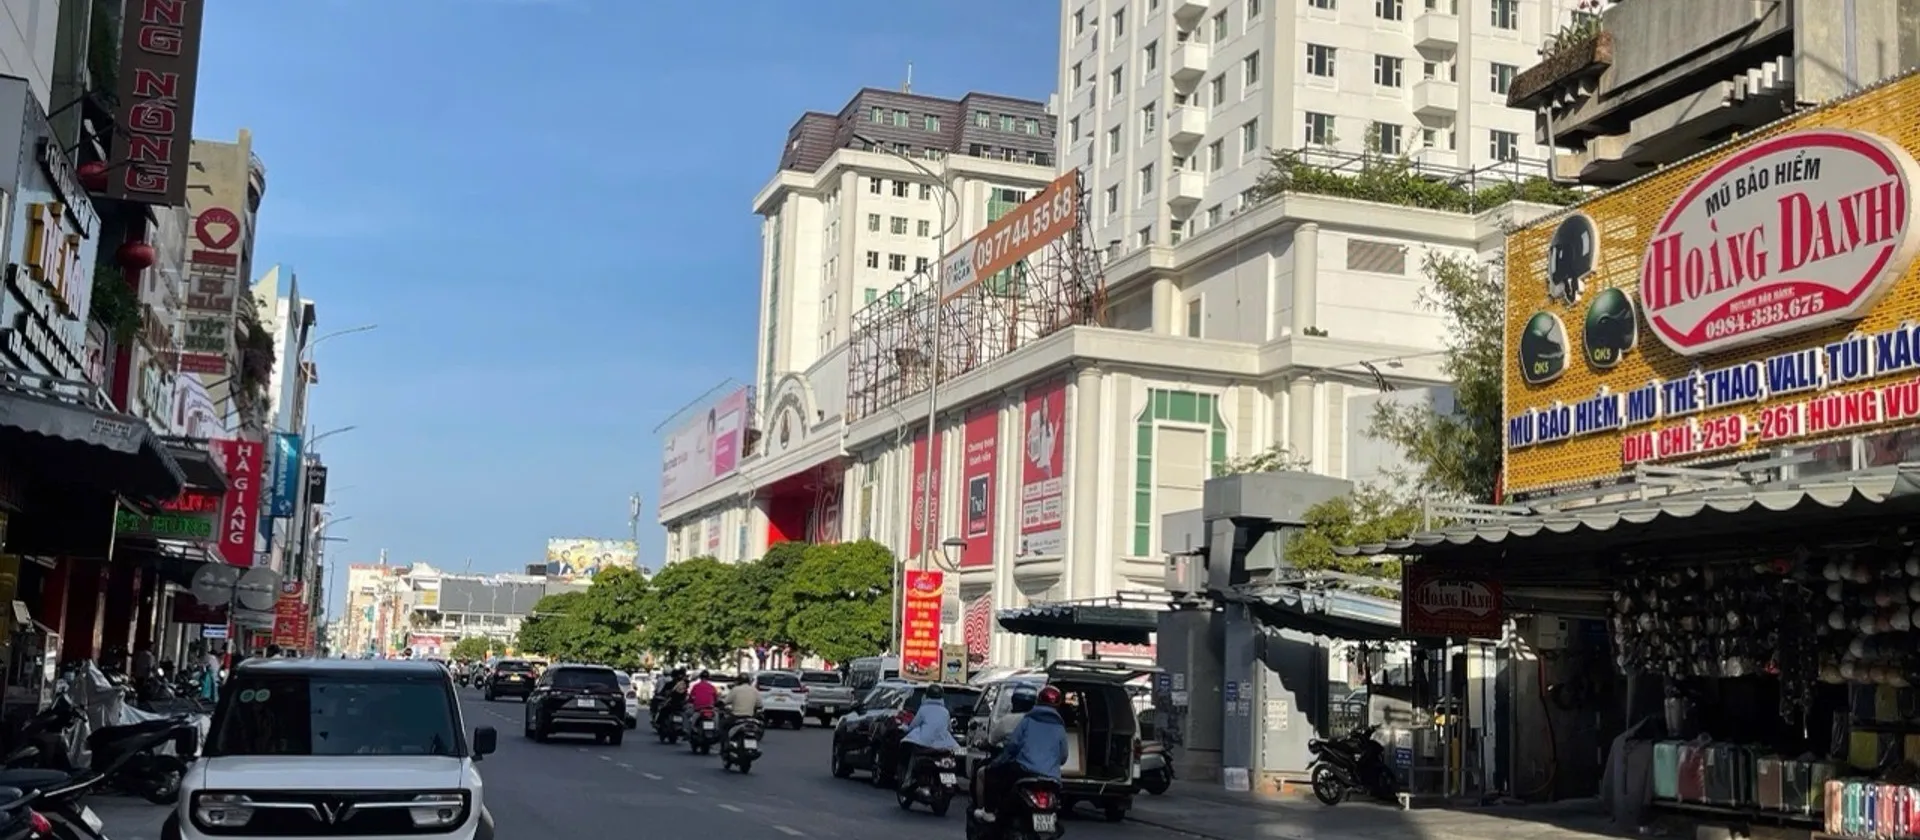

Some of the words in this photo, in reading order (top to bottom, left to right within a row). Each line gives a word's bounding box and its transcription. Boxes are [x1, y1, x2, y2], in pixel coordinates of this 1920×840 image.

[1704, 183, 1731, 217] MŨ
[1736, 165, 1769, 201] BẢO
[1774, 150, 1821, 185] HIỂM
[977, 238, 993, 270] 09
[1032, 200, 1050, 238] 55
[1777, 180, 1895, 273] DANH
[1705, 292, 1824, 339] 0984.333.675
[1826, 333, 1868, 381] TÚI
[1703, 415, 1740, 449] 259
[1761, 407, 1800, 439] 261
[235, 444, 252, 471] HÀ
[229, 477, 248, 544] GIANG
